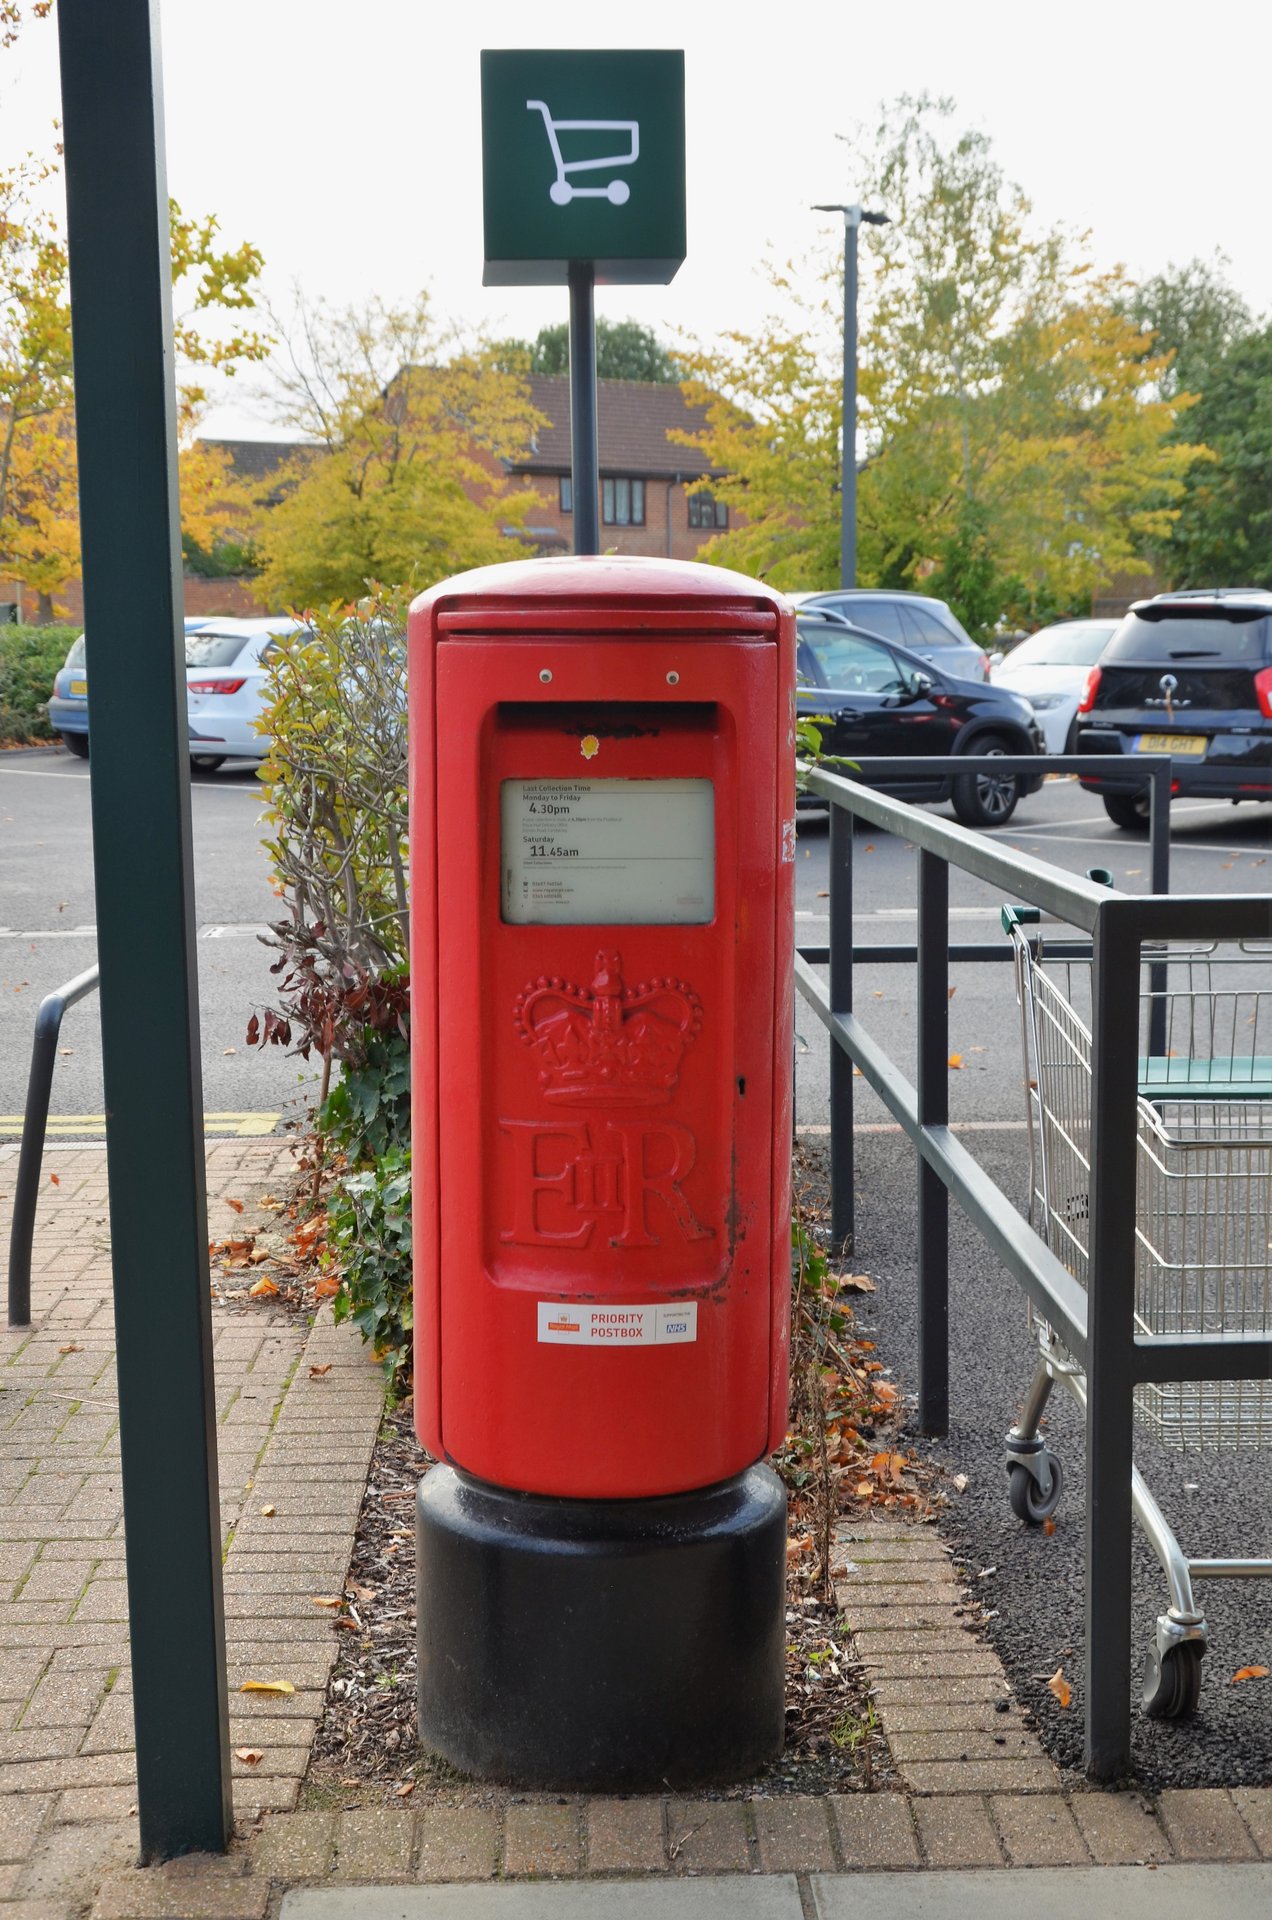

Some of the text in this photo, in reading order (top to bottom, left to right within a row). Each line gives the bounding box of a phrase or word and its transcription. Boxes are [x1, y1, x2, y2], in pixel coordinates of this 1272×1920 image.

[522, 794, 550, 802] Monday
[559, 794, 581, 802] Friday
[529, 802, 570, 815] 4.30pm
[530, 845, 579, 857] 11.45am
[591, 1313, 644, 1324] PRIORITY
[591, 1327, 643, 1338] POSTBOX
[667, 1323, 686, 1333] NHS
